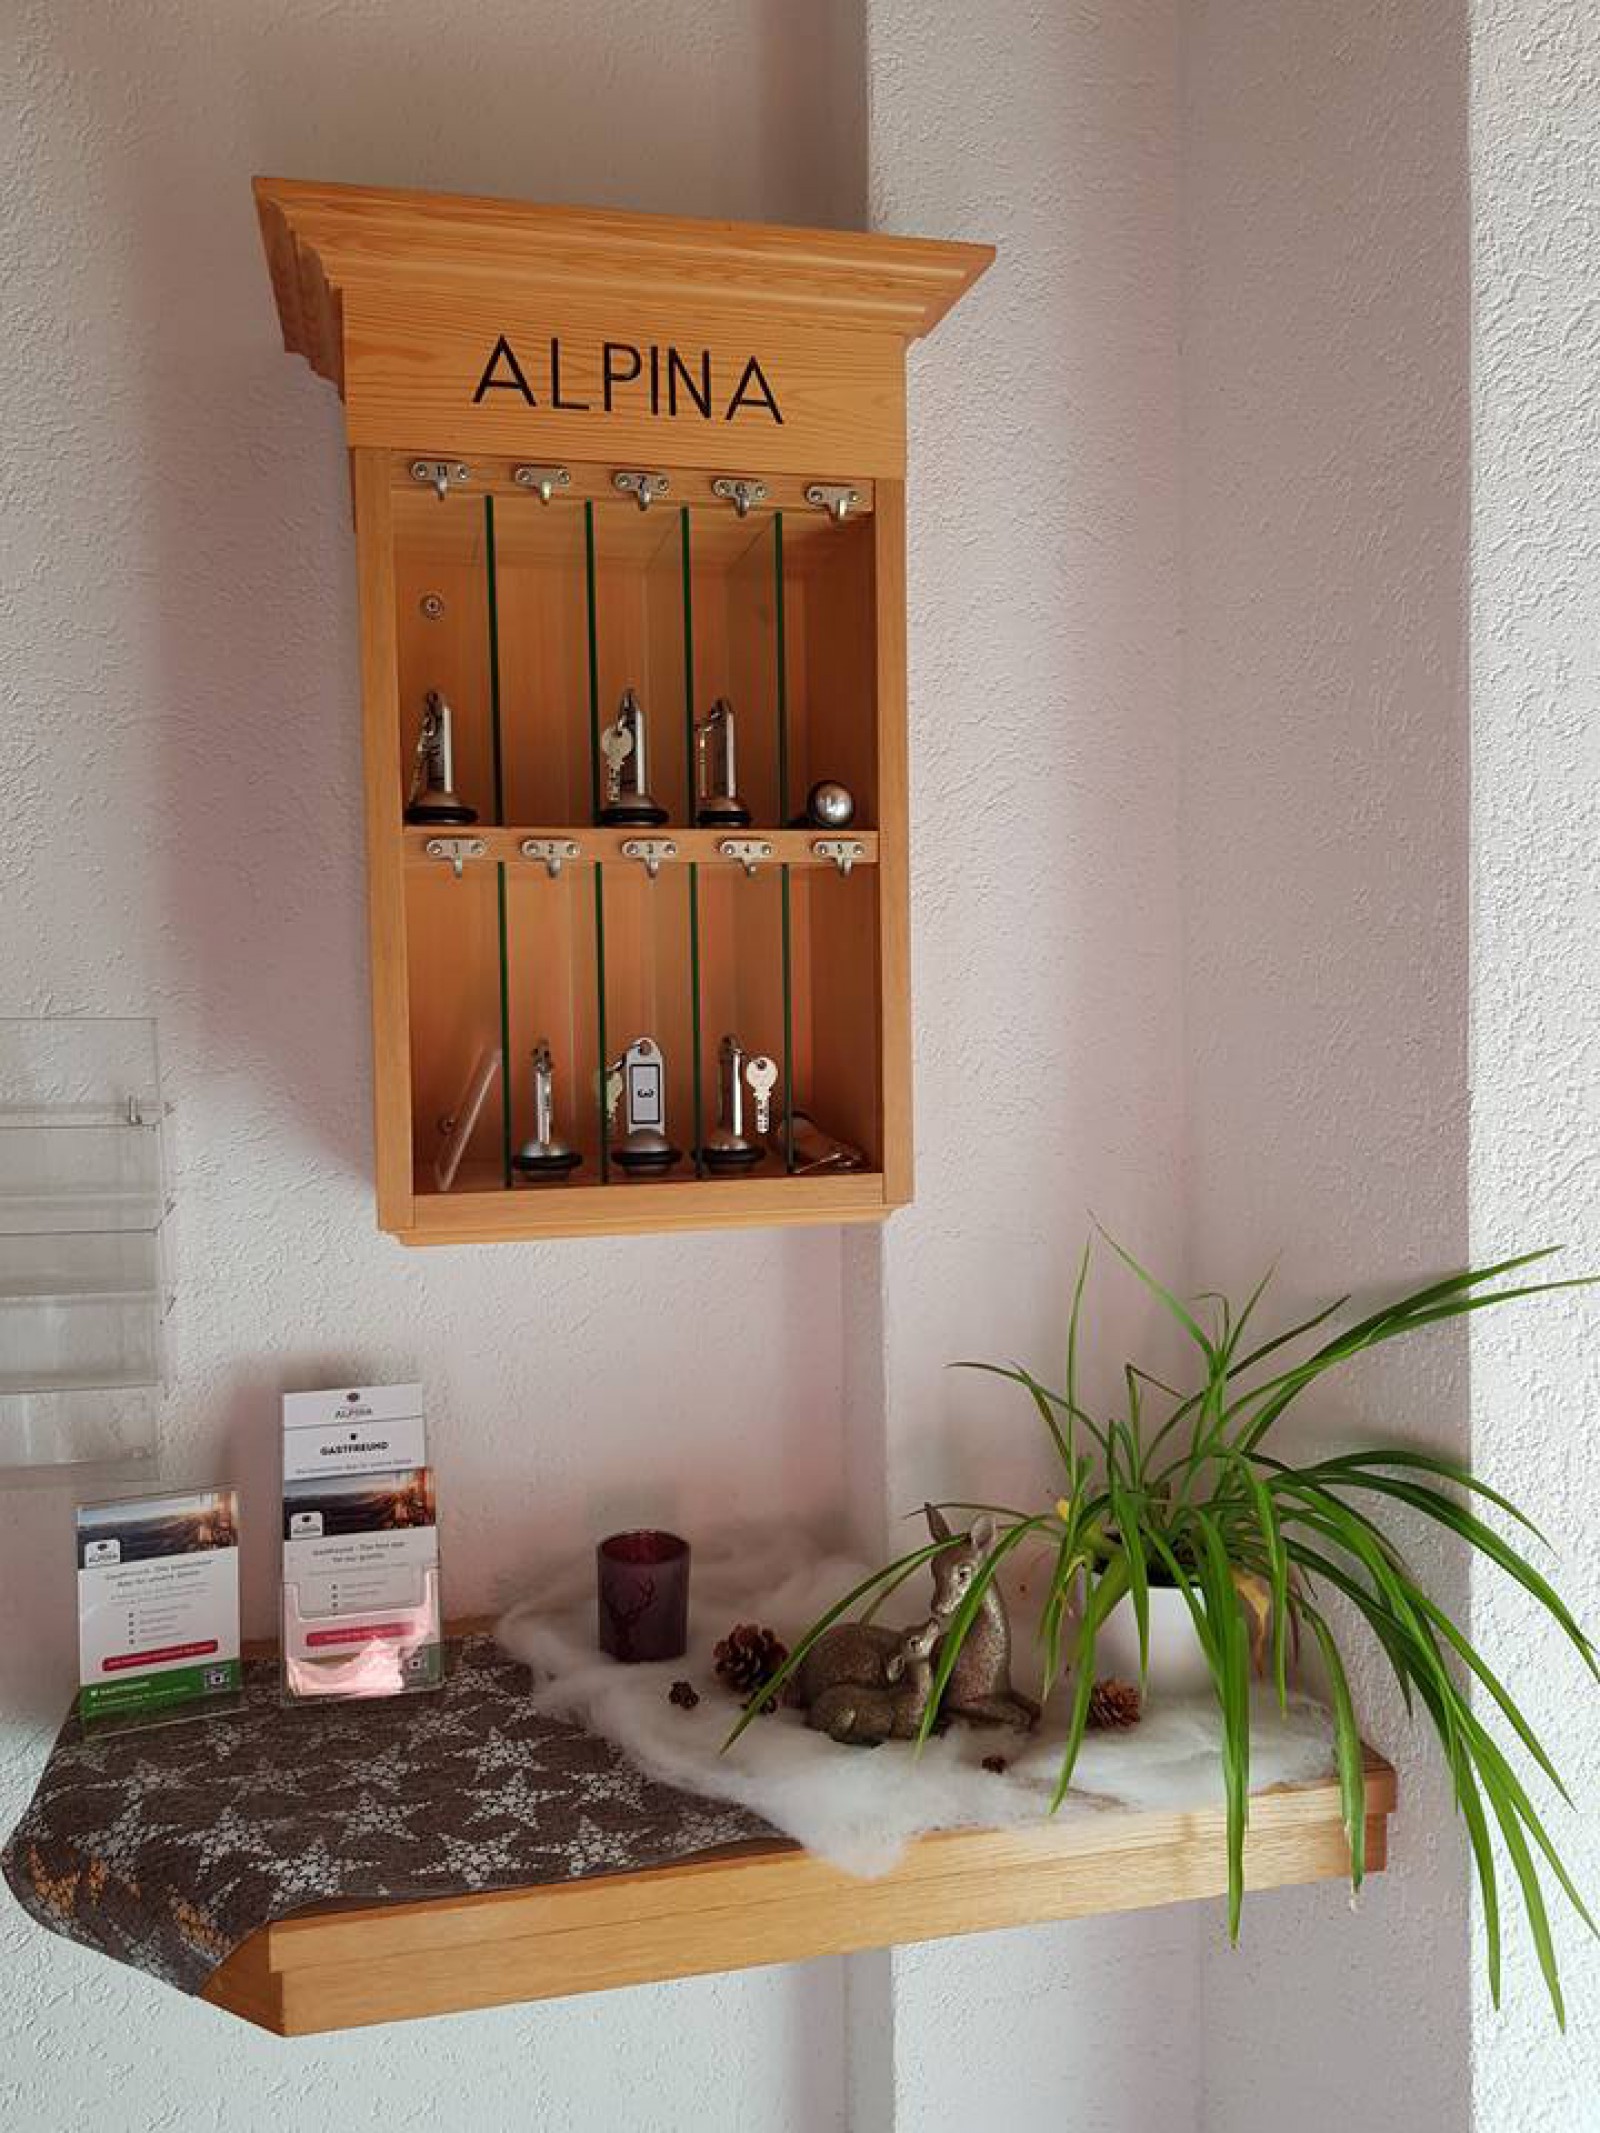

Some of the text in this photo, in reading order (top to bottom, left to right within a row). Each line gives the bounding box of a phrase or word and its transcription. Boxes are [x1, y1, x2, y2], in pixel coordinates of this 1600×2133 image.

[472, 333, 784, 425] ALPINA
[548, 842, 555, 853] 2
[743, 843, 750, 853] 4
[637, 1089, 655, 1098] 3
[320, 1441, 389, 1456] GASTFREUND
